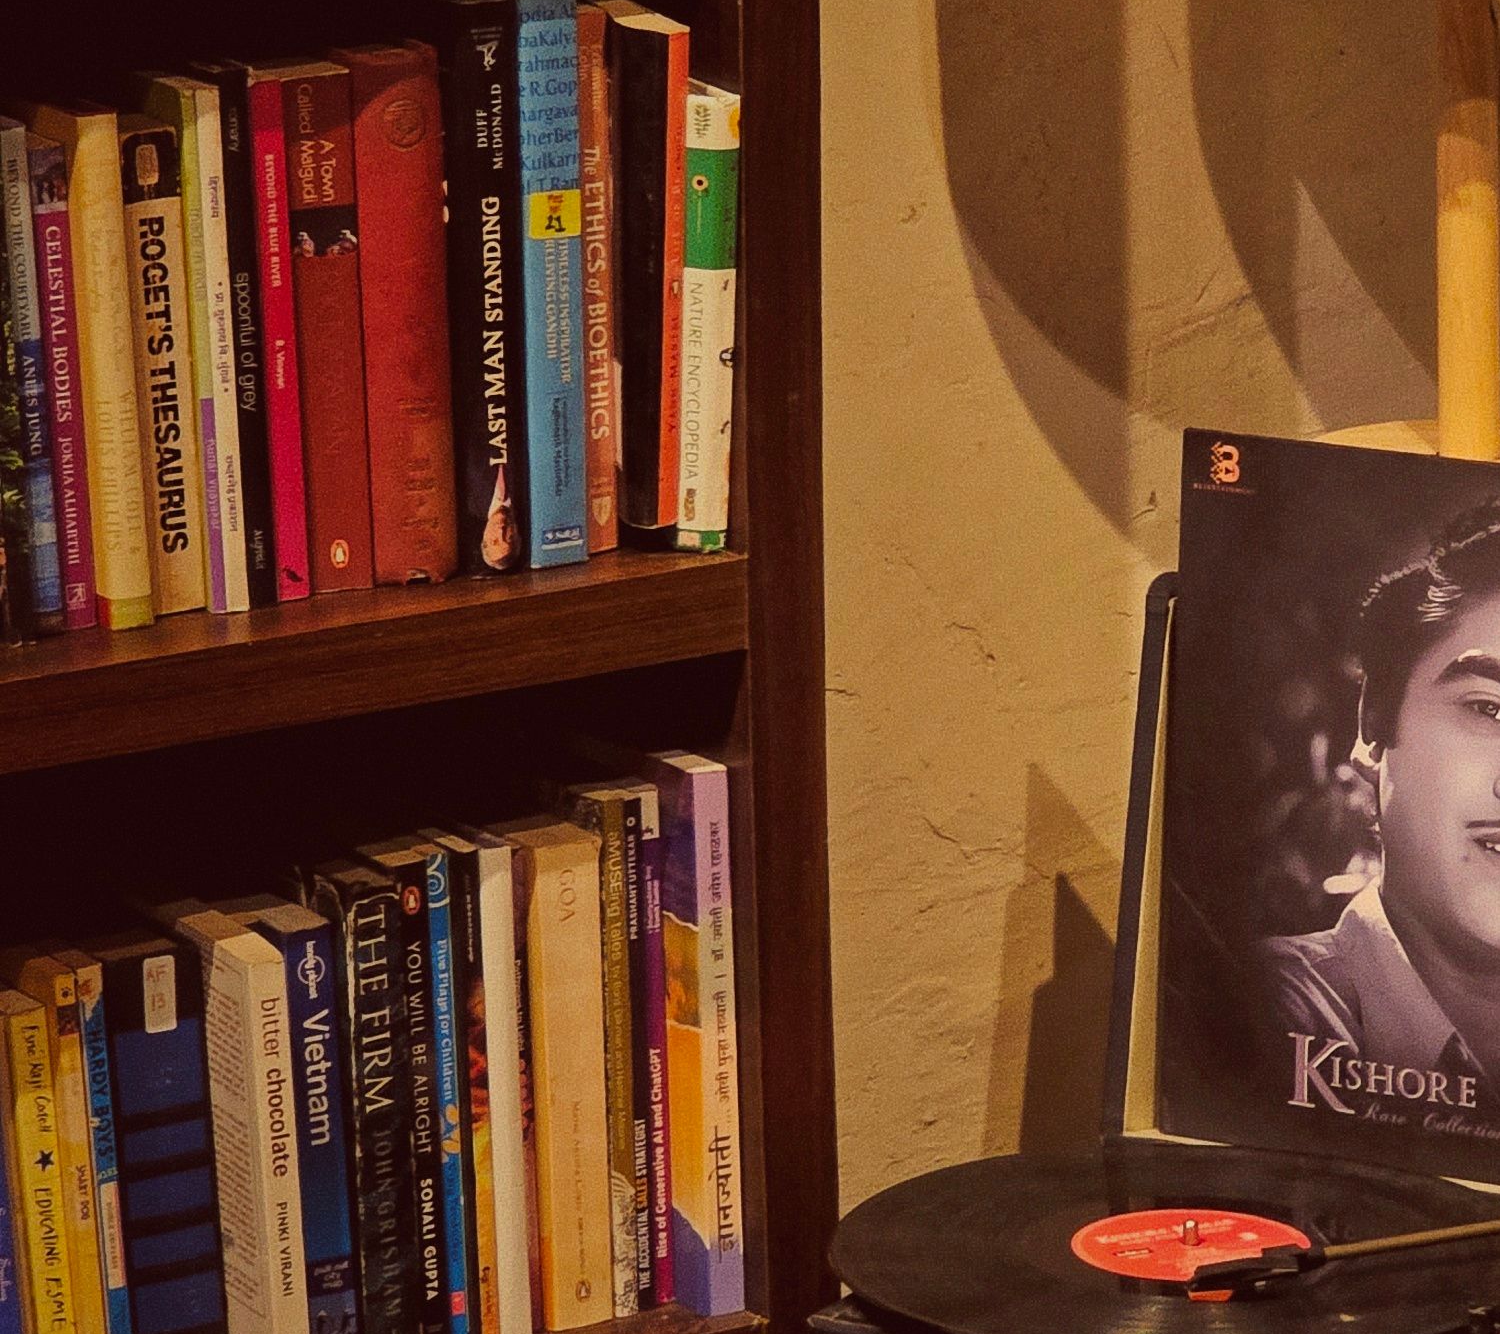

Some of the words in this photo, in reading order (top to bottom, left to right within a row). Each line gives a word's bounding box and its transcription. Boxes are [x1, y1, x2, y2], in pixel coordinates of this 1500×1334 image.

[297, 83, 316, 135] Called
[475, 108, 489, 148] DUFF
[298, 139, 319, 205] Malgudi
[319, 139, 335, 157] A
[582, 145, 602, 177] The
[320, 159, 337, 201] Town
[583, 181, 607, 274] ETHICS
[45, 224, 69, 342] CELESTIAL
[137, 216, 174, 357] ROGET'S
[480, 195, 505, 324] STANDING
[585, 277, 604, 295] of
[231, 271, 257, 347] spoonful
[687, 281, 705, 354] NATURE
[52, 345, 75, 424] BODIES
[240, 351, 258, 369] of
[484, 329, 507, 395] MAN
[587, 300, 611, 443] BIOETHICS
[238, 373, 260, 413] grey
[683, 359, 704, 480] ENCYCLOPEDIA
[58, 436, 78, 485] JOKHA
[151, 360, 190, 555] THESAURUS
[486, 402, 509, 465] LAST
[61, 488, 81, 566] ALHARTHI
[354, 903, 391, 998] THE
[406, 940, 424, 988] YOU
[260, 997, 286, 1060] bitter
[408, 994, 426, 1036] WILL
[301, 1008, 332, 1147] Vietnam
[359, 1009, 394, 1116] FIRM
[410, 1044, 427, 1066] BE
[648, 1047, 663, 1102] ChatGPT
[266, 1067, 292, 1179] chocolate
[413, 1074, 432, 1155] ALRIGHT
[651, 1104, 663, 1129] and
[651, 1130, 664, 1144] AI
[418, 1177, 438, 1240] SONALI
[653, 1147, 667, 1214] Generative
[275, 1200, 290, 1243] PINKI
[656, 1216, 668, 1229] of
[656, 1232, 669, 1259] Rise
[279, 1246, 295, 1298] VIRANI
[422, 1244, 440, 1302] GUPTA
